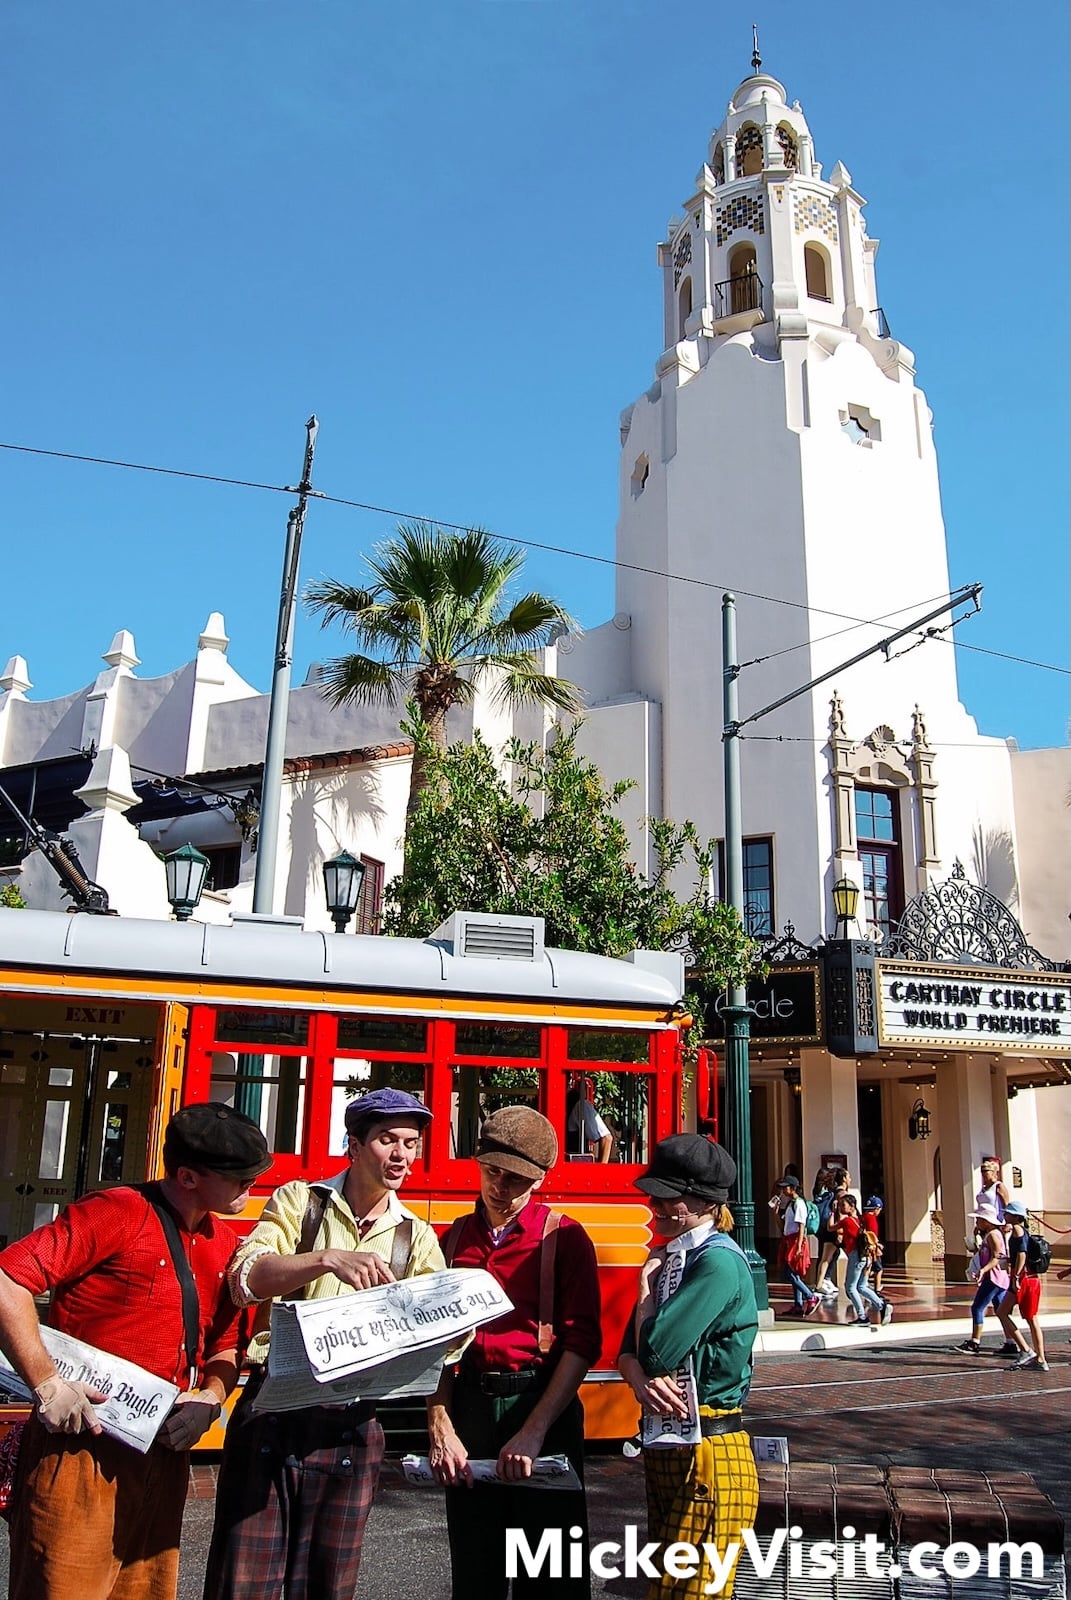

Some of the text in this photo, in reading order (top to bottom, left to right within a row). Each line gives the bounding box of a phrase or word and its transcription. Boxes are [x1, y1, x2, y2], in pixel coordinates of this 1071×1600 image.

[889, 981, 1067, 1013] CARTHAY CIRCLE
[65, 1007, 125, 1025] EXIT
[902, 1009, 1062, 1035] WORLD PREMIERE
[43, 1187, 67, 1196] KEEP
[413, 1299, 469, 1326] Buena
[466, 1290, 503, 1311] The
[369, 1315, 415, 1342] Vista
[313, 1322, 369, 1364] Bugle
[113, 1382, 164, 1421] Bugle
